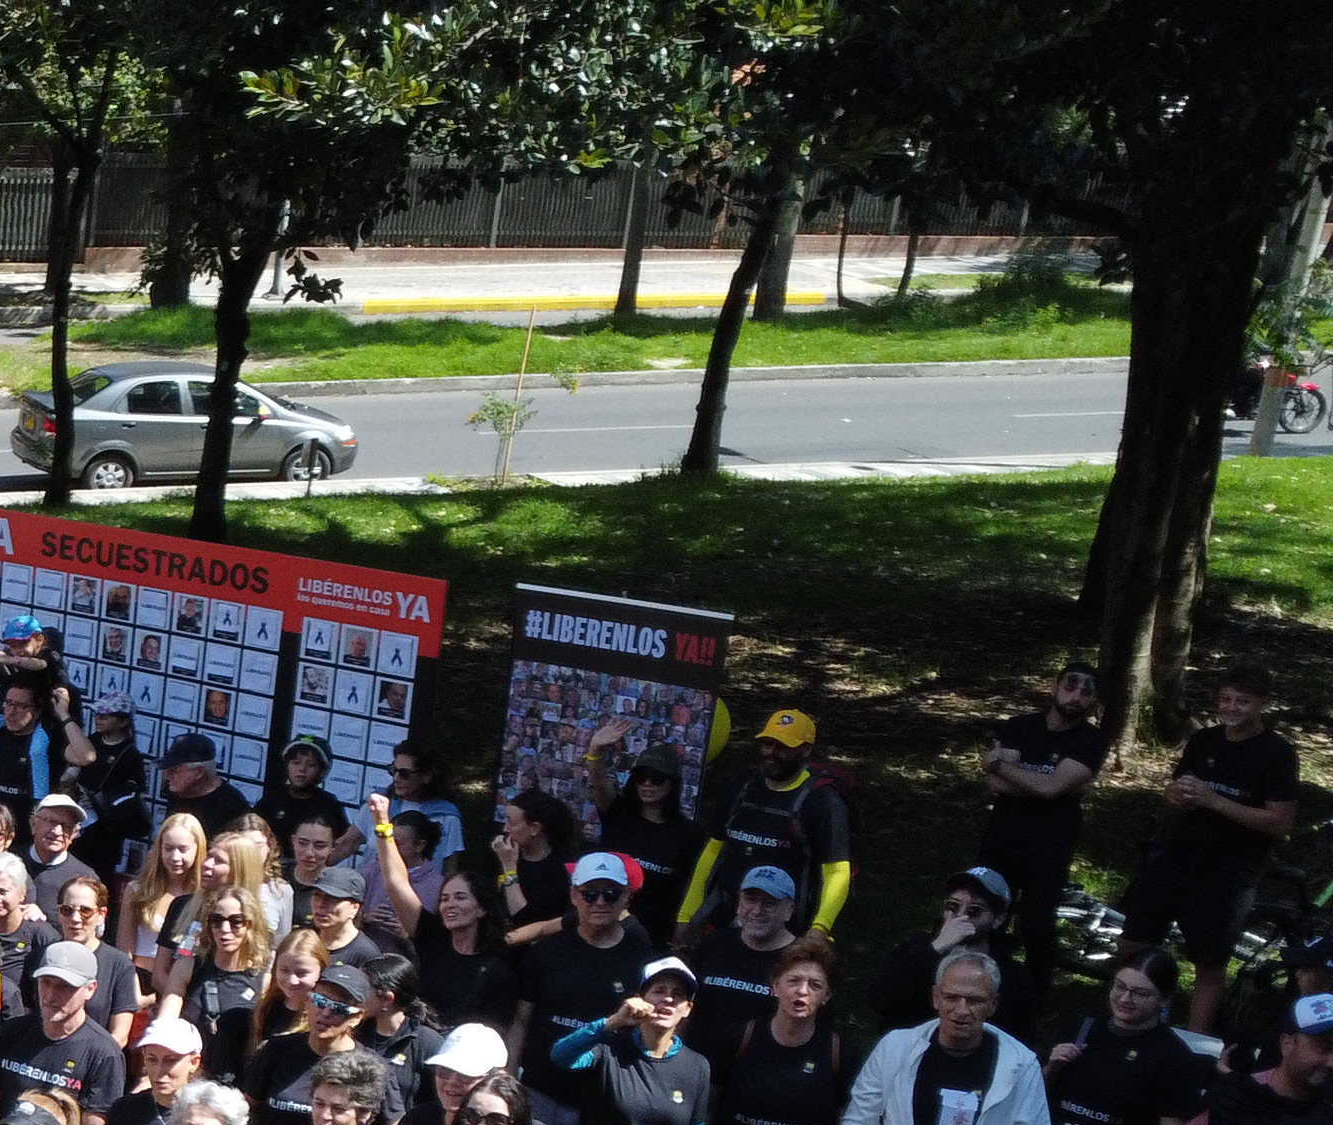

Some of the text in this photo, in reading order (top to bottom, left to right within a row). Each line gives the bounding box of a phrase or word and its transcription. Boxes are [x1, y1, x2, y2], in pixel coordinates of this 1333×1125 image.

[40, 530, 270, 594] SECUESTRADOS
[298, 577, 431, 623] LIBÉRENLOS YA
[311, 596, 354, 612] queremos
[369, 605, 391, 617] casa
[524, 610, 716, 667] #LIBERENLOS YA!!
[705, 976, 771, 996] #LIBÉRENLOS
